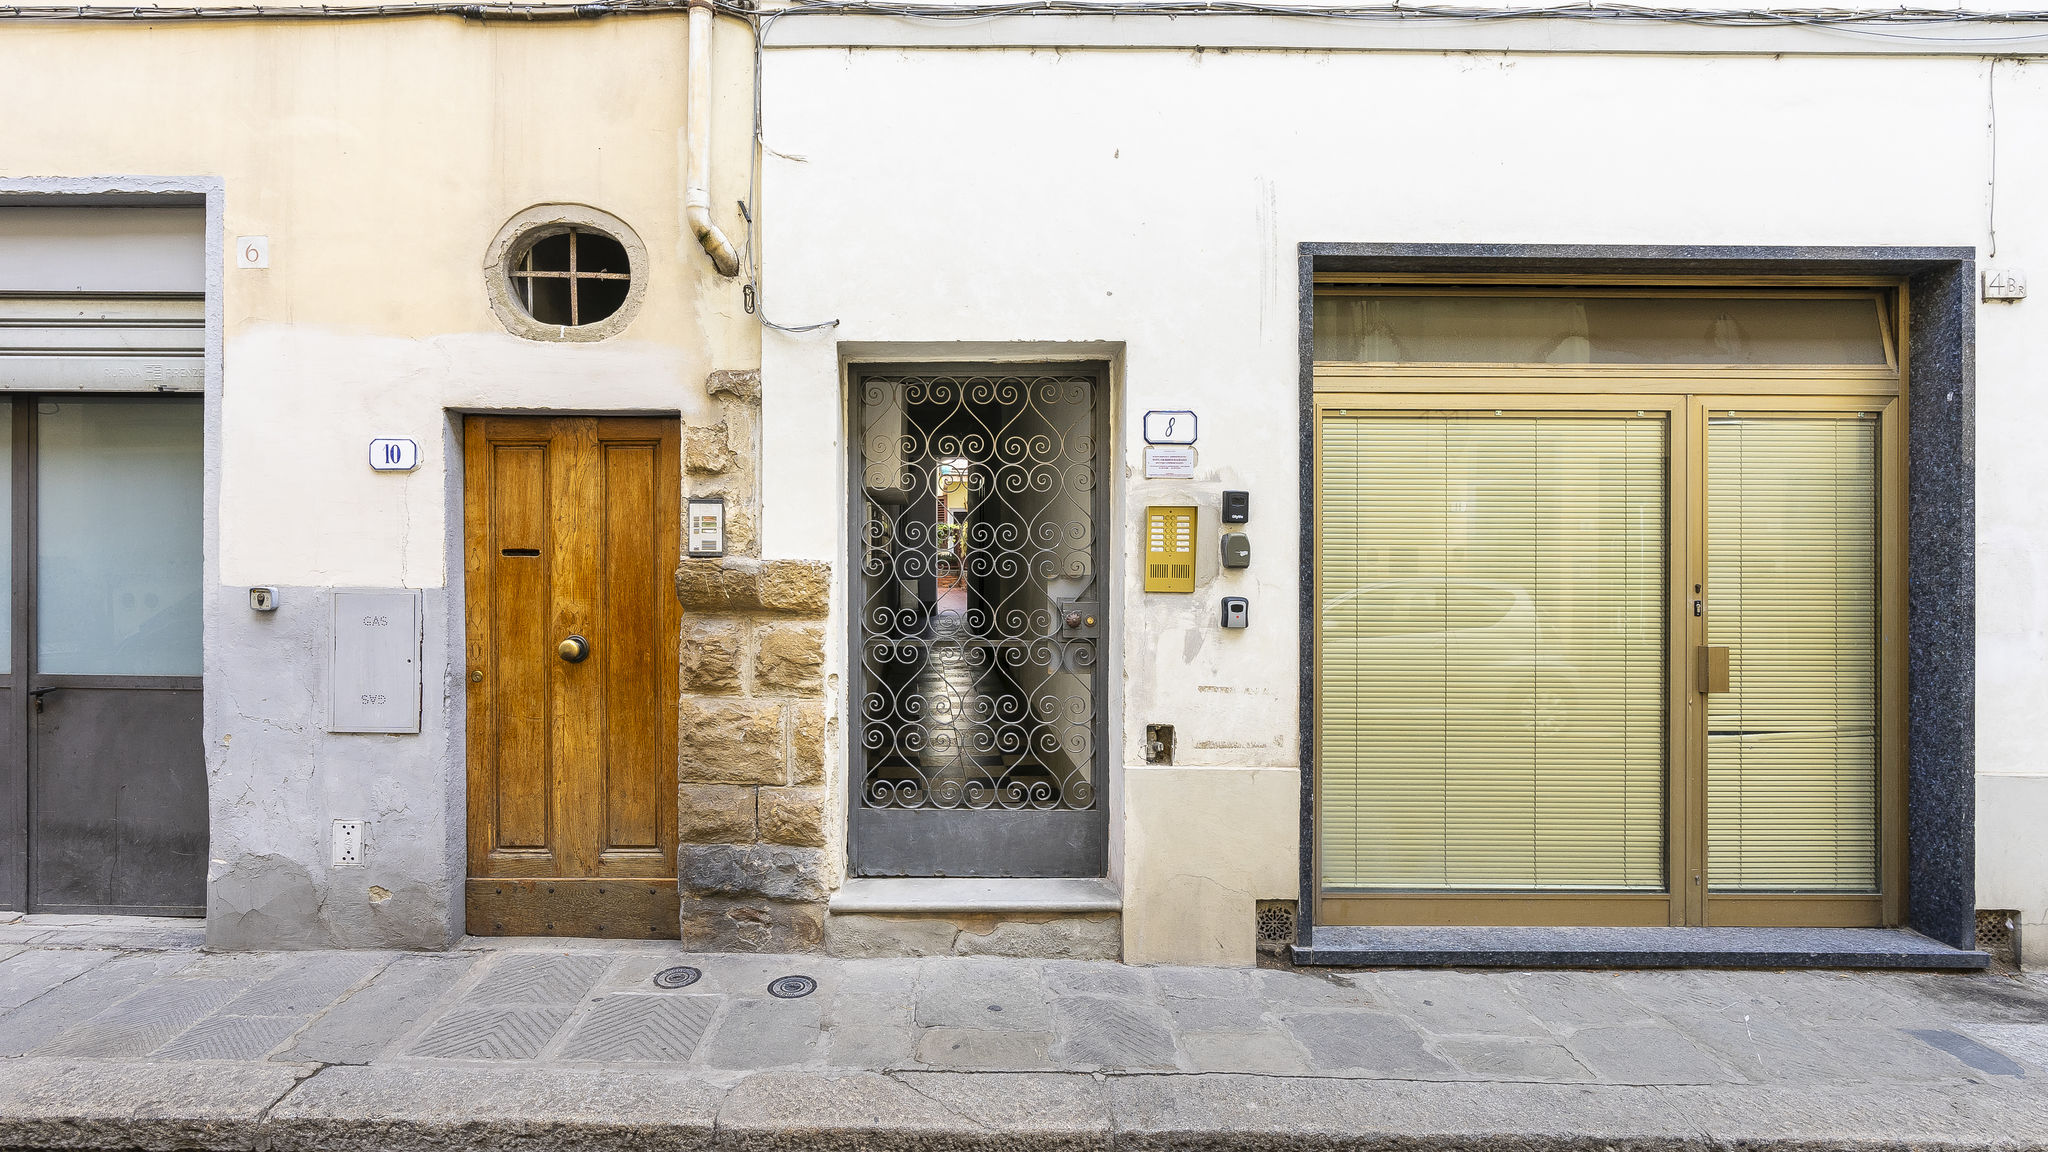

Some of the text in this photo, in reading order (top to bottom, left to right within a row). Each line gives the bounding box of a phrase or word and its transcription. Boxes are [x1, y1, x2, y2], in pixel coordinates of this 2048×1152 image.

[245, 241, 259, 263] 6
[1164, 417, 1176, 438] 8
[384, 443, 401, 464] 10
[362, 615, 388, 627] GAS
[361, 694, 387, 705] GAS
